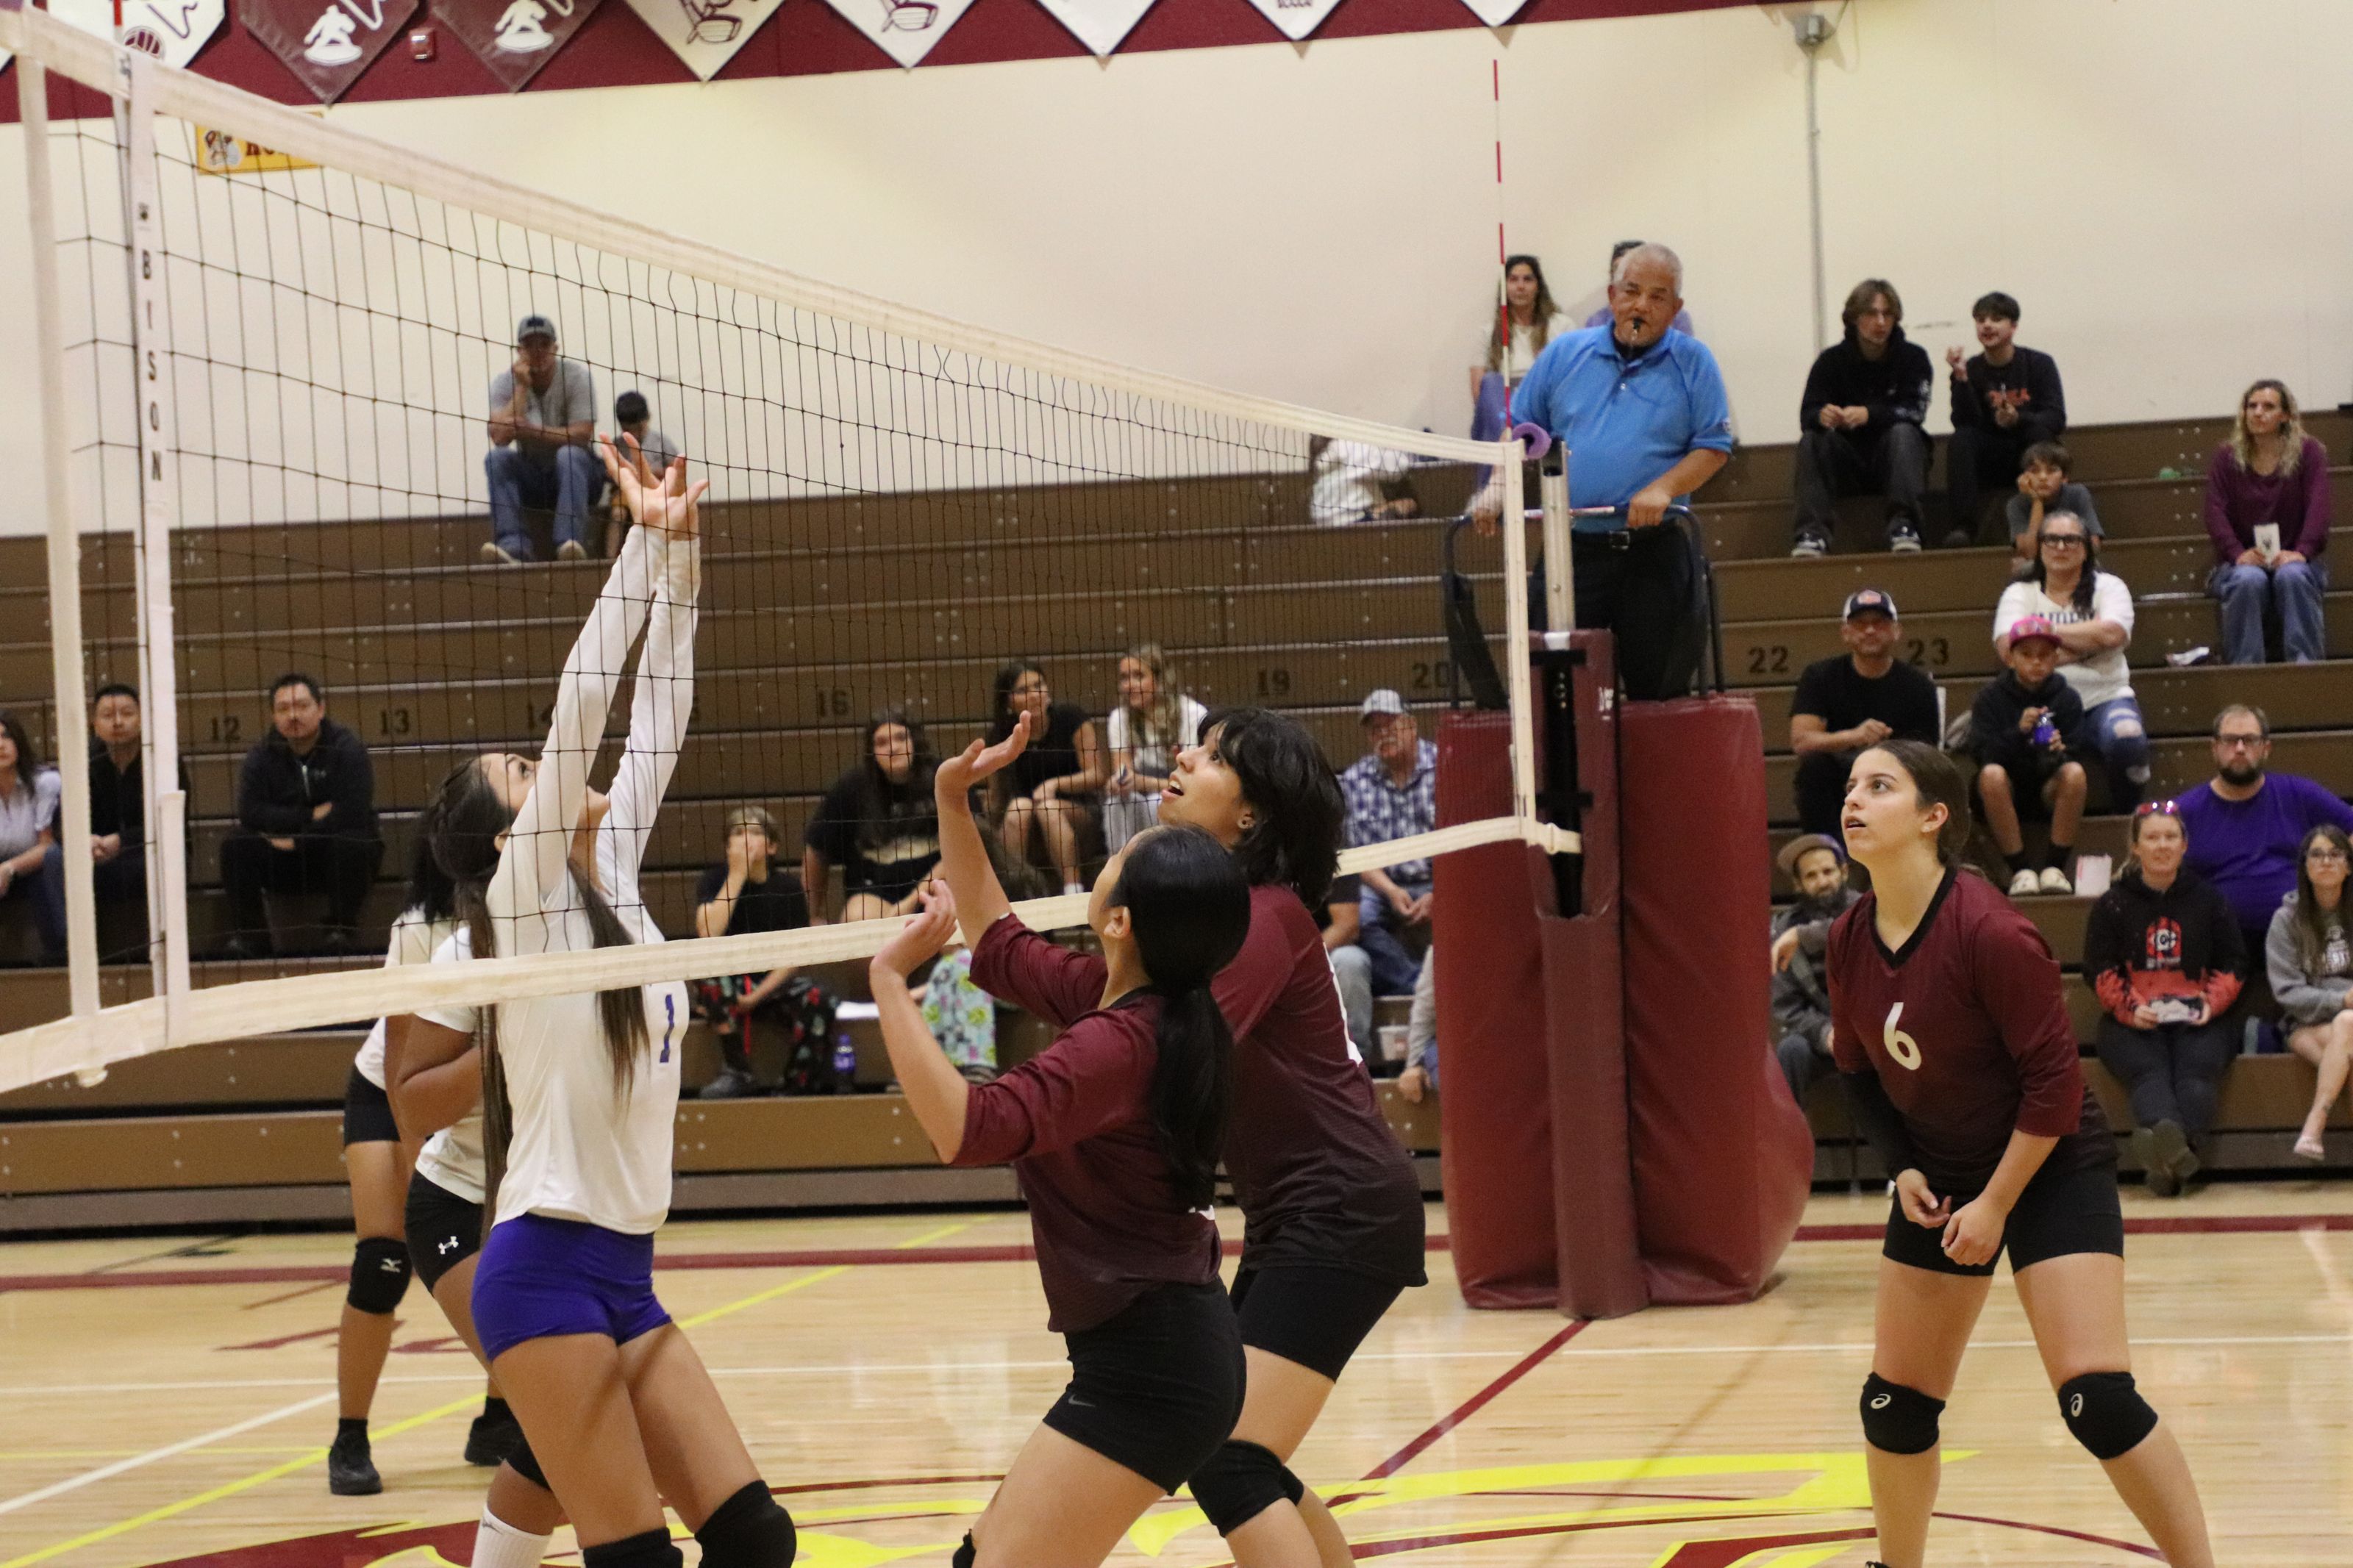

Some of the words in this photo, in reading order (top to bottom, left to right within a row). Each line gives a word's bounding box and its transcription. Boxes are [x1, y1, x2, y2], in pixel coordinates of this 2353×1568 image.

[143, 249, 162, 482] BISON
[1748, 645, 1789, 674] 22
[1907, 637, 1948, 666] 23
[1257, 667, 1290, 696] 19
[818, 691, 849, 717] 16
[211, 716, 240, 742] 12
[380, 708, 410, 735] 13
[660, 994, 674, 1063] 1
[1884, 1002, 1921, 1070] 6
